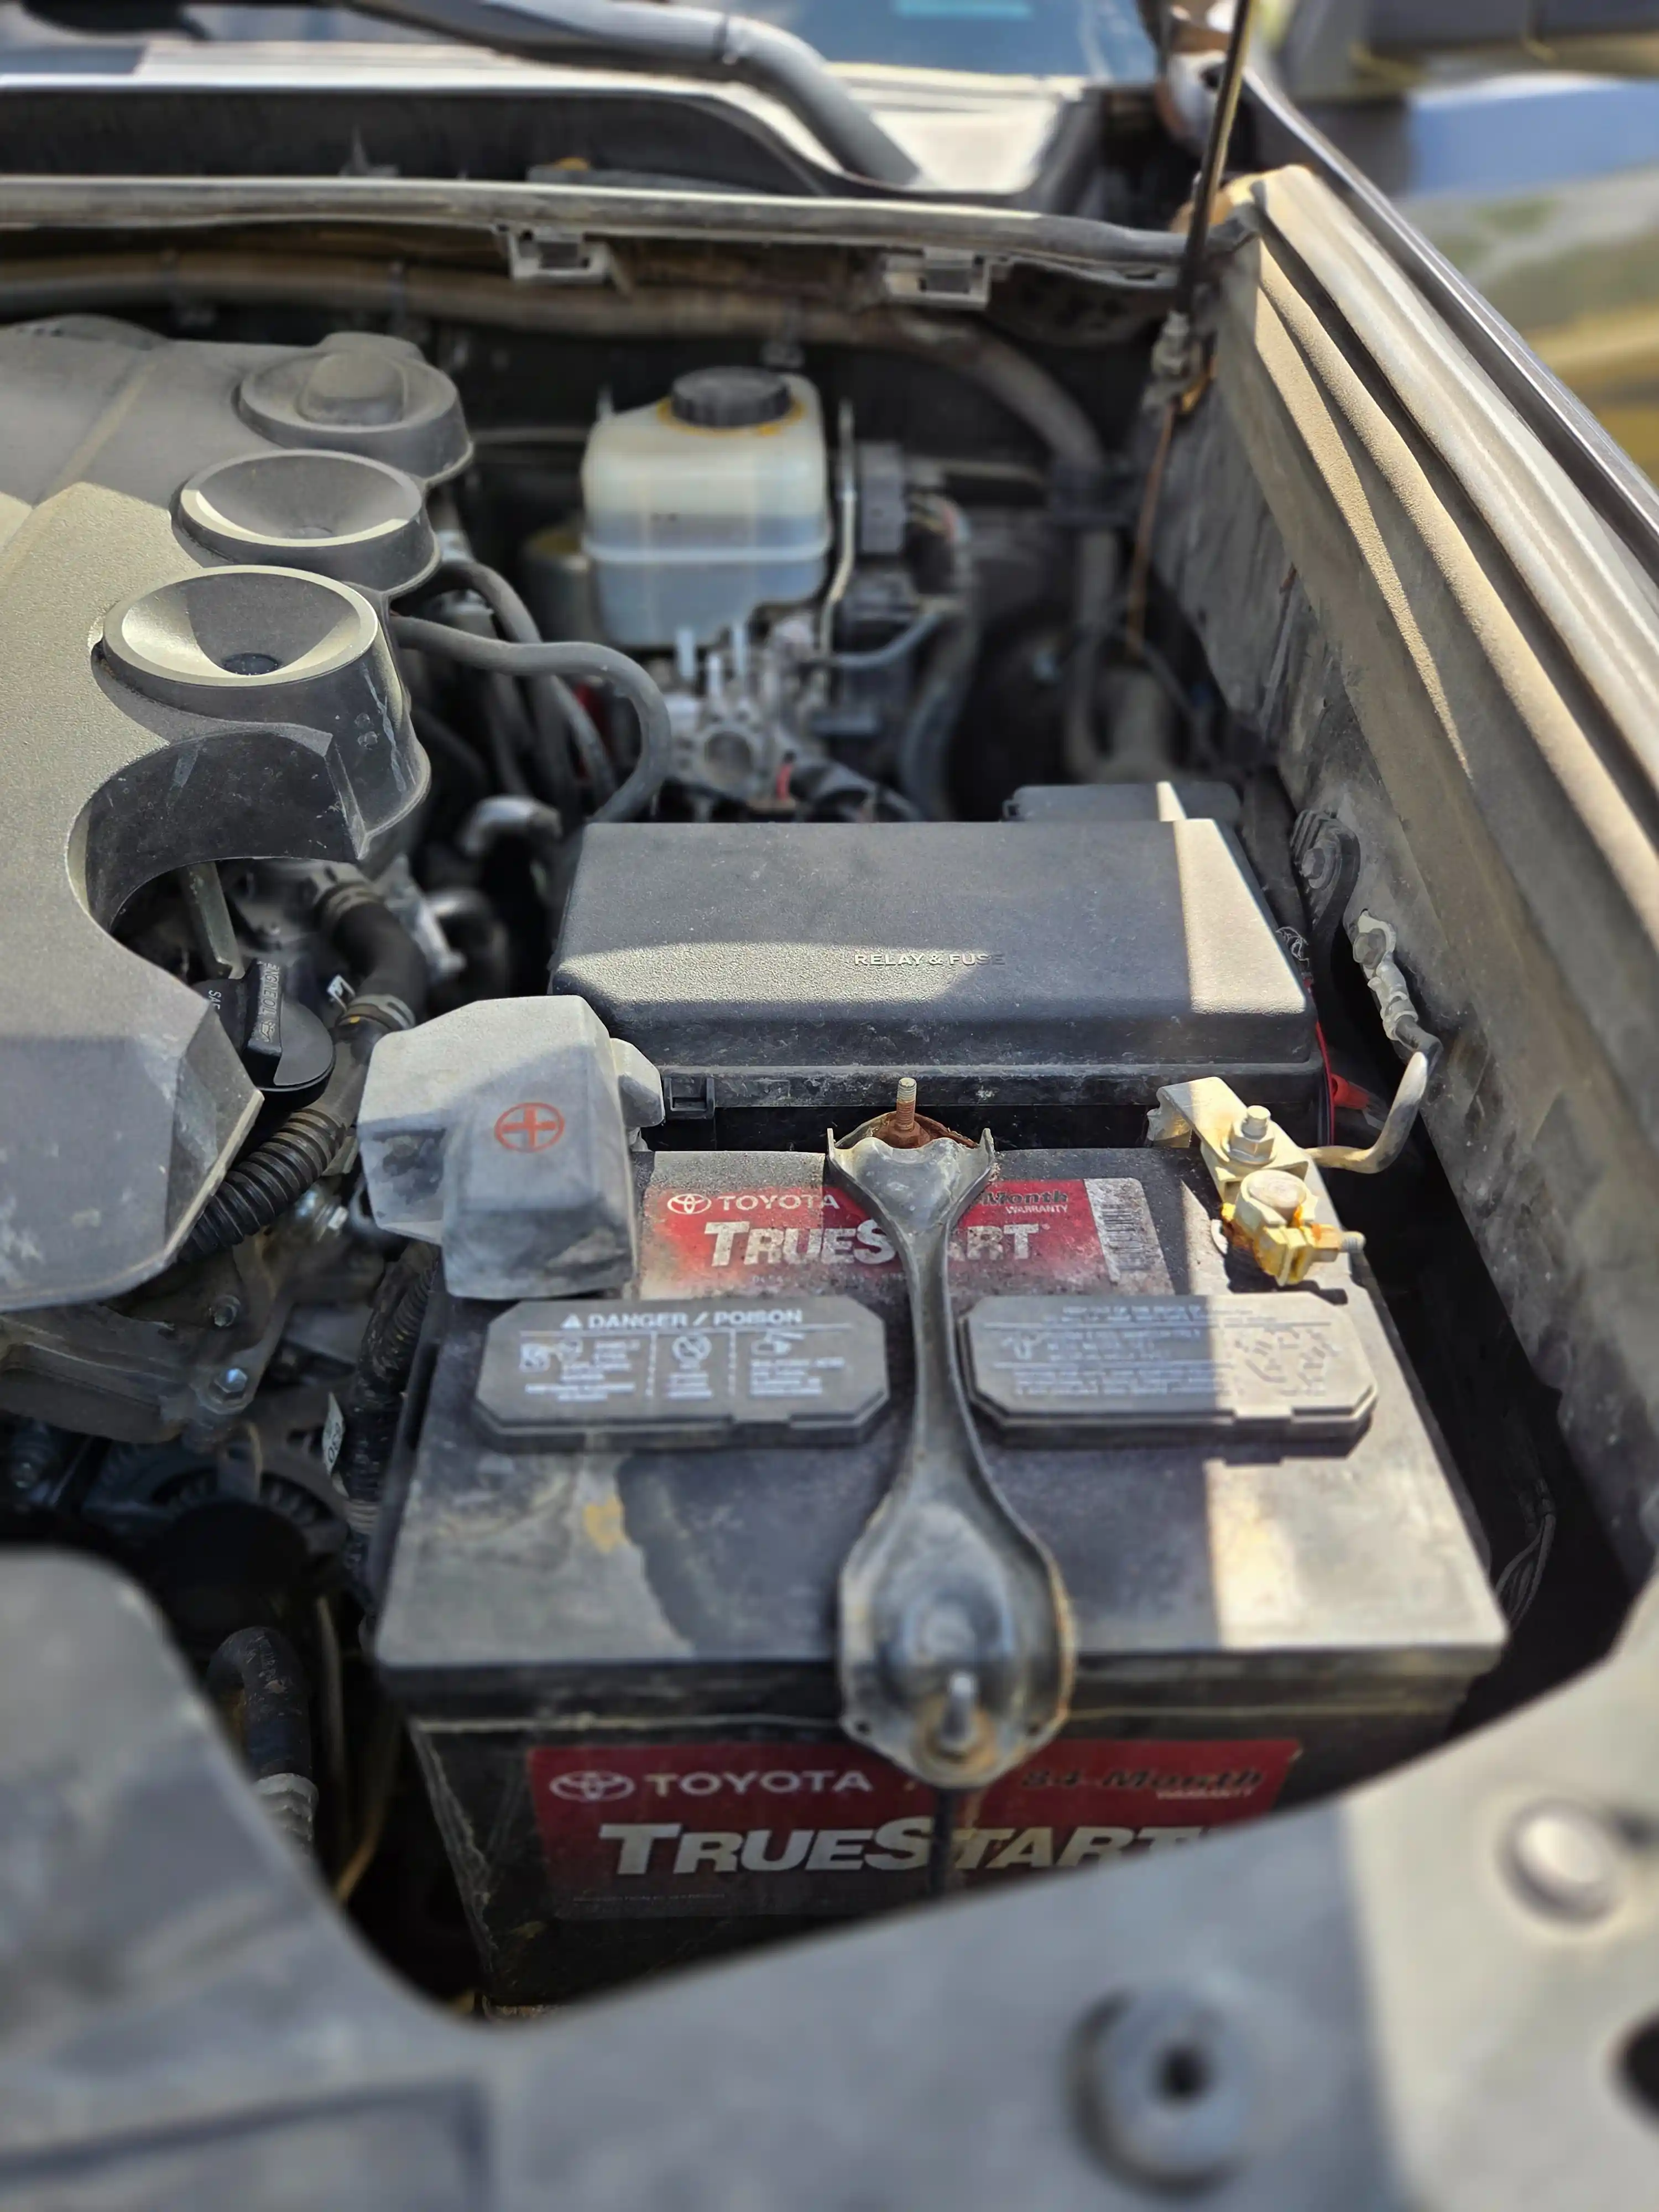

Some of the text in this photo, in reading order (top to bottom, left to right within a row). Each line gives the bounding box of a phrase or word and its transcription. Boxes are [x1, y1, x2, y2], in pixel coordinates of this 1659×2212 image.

[854, 953, 1006, 966] RELAY & FUSE
[262, 963, 280, 1014] ENGINE OIL
[722, 1194, 841, 1211] TOYOTA
[1005, 1204, 1068, 1214] WARRANTY
[588, 1308, 803, 1328] DANGER / POISON
[645, 1770, 873, 1797] TOYOTA
